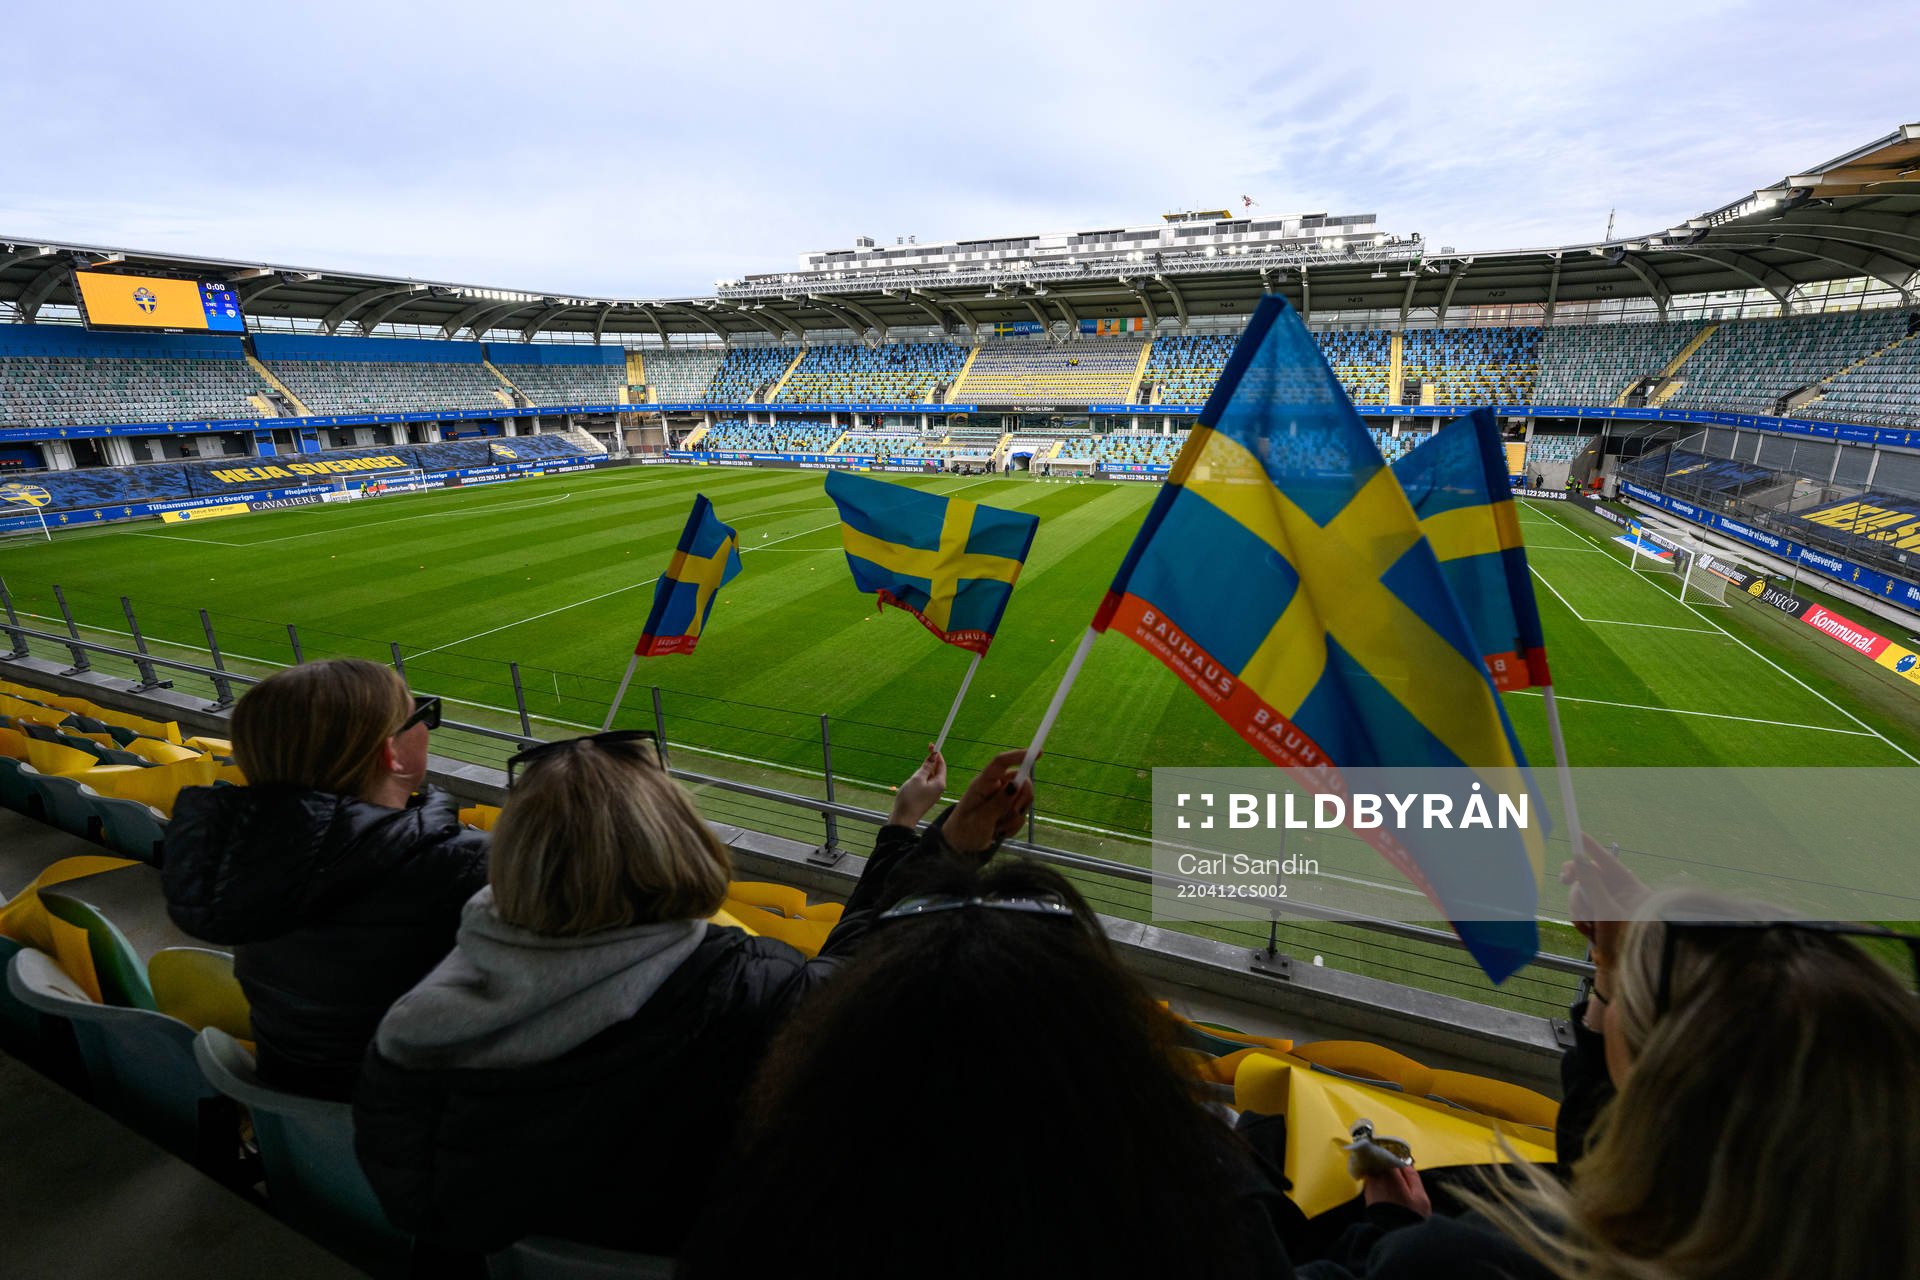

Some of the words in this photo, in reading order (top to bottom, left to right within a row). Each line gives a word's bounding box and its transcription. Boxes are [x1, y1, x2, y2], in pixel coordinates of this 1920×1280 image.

[206, 282, 225, 292] 0:00
[206, 292, 212, 300] 0
[224, 293, 230, 301] 0
[211, 465, 295, 483] HEJA
[287, 455, 408, 476] SVERIGE!
[427, 473, 447, 481] Sverige
[284, 484, 330, 496] #hejasverige
[147, 500, 204, 511] Tillsammans
[223, 493, 255, 502] Sverige
[253, 495, 319, 511] CAVALIERE
[1720, 517, 1750, 537] Tillsammans
[1759, 532, 1779, 548] Sverige
[1800, 548, 1843, 573] #hejasverige
[1762, 588, 1800, 614] BASECO
[1141, 610, 1232, 693] BAUHAUS
